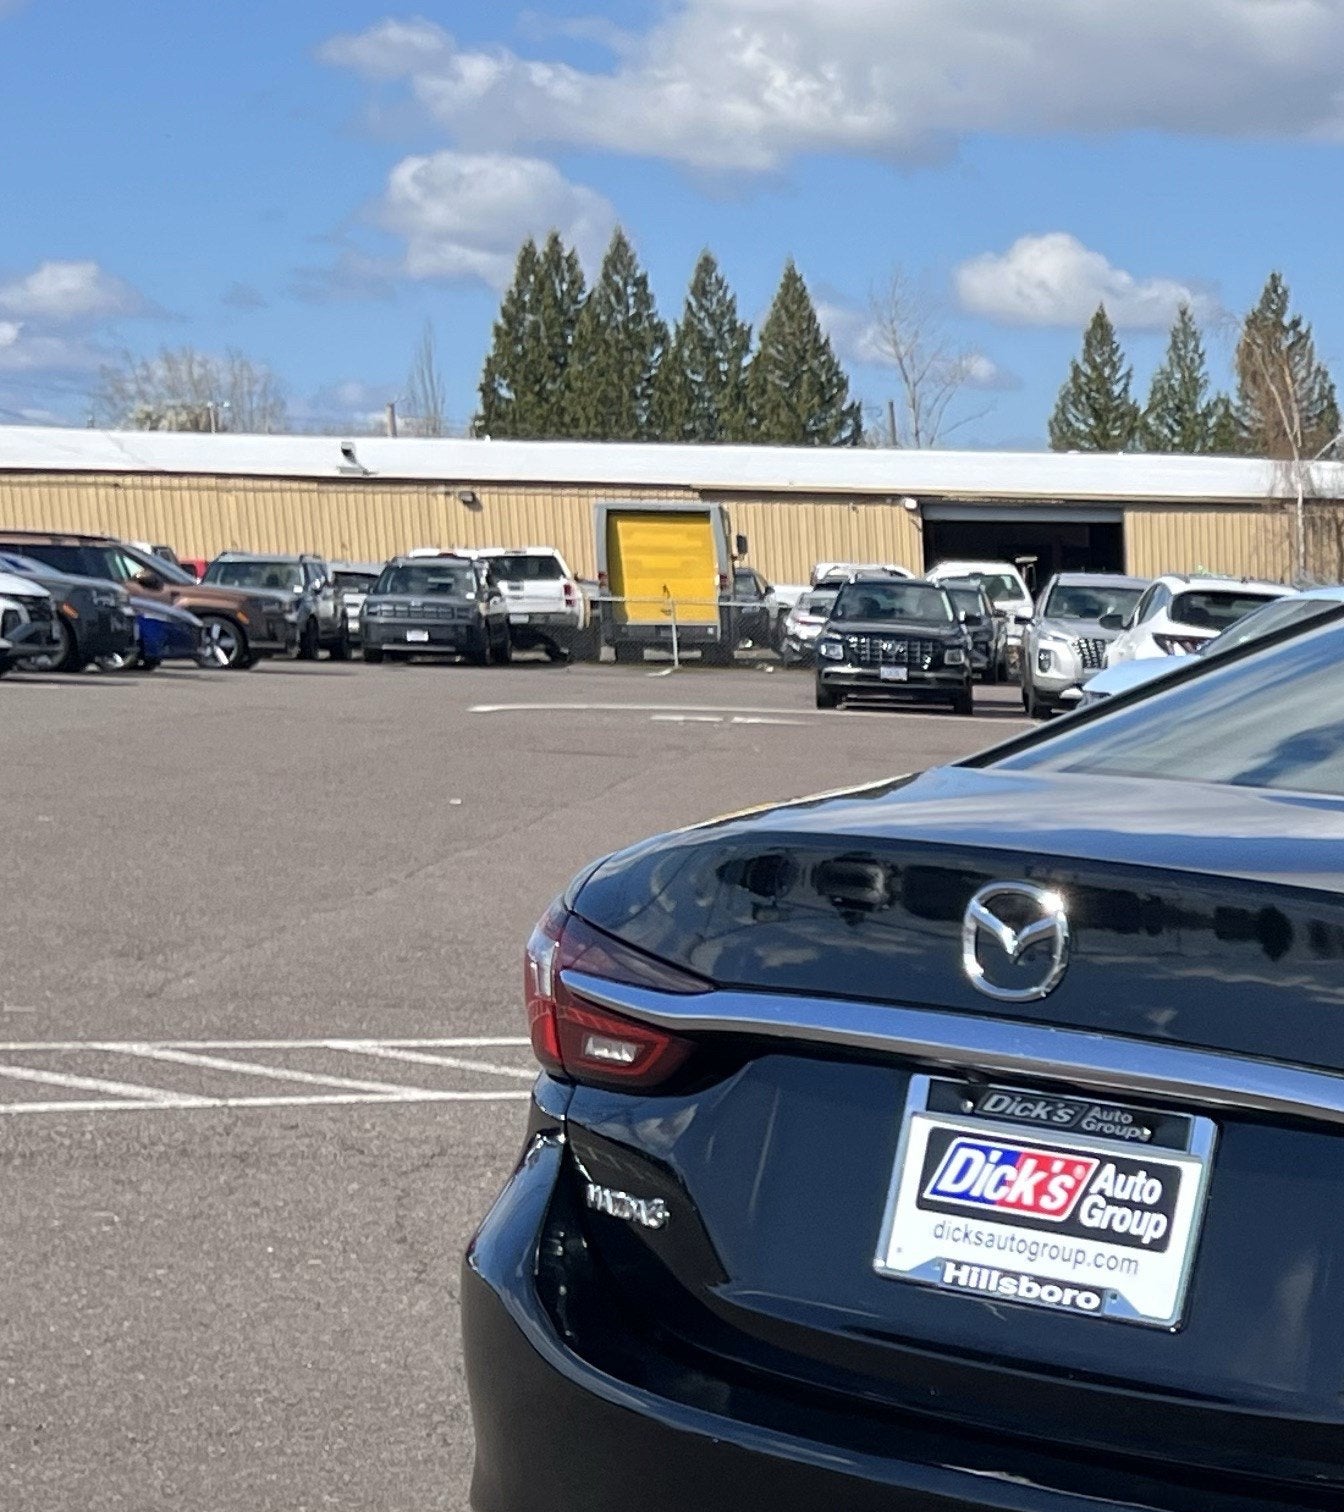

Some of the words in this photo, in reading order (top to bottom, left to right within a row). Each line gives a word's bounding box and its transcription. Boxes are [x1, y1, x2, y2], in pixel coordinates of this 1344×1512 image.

[982, 1093, 1075, 1124] Dick's
[1087, 1105, 1134, 1125] Auto
[937, 1145, 1075, 1211] Dick's
[1089, 1163, 1163, 1206] Auto
[1079, 1195, 1168, 1245] Group
[933, 1219, 1139, 1276] dicksautogroup.com
[942, 1260, 1101, 1310] Hillsboro
